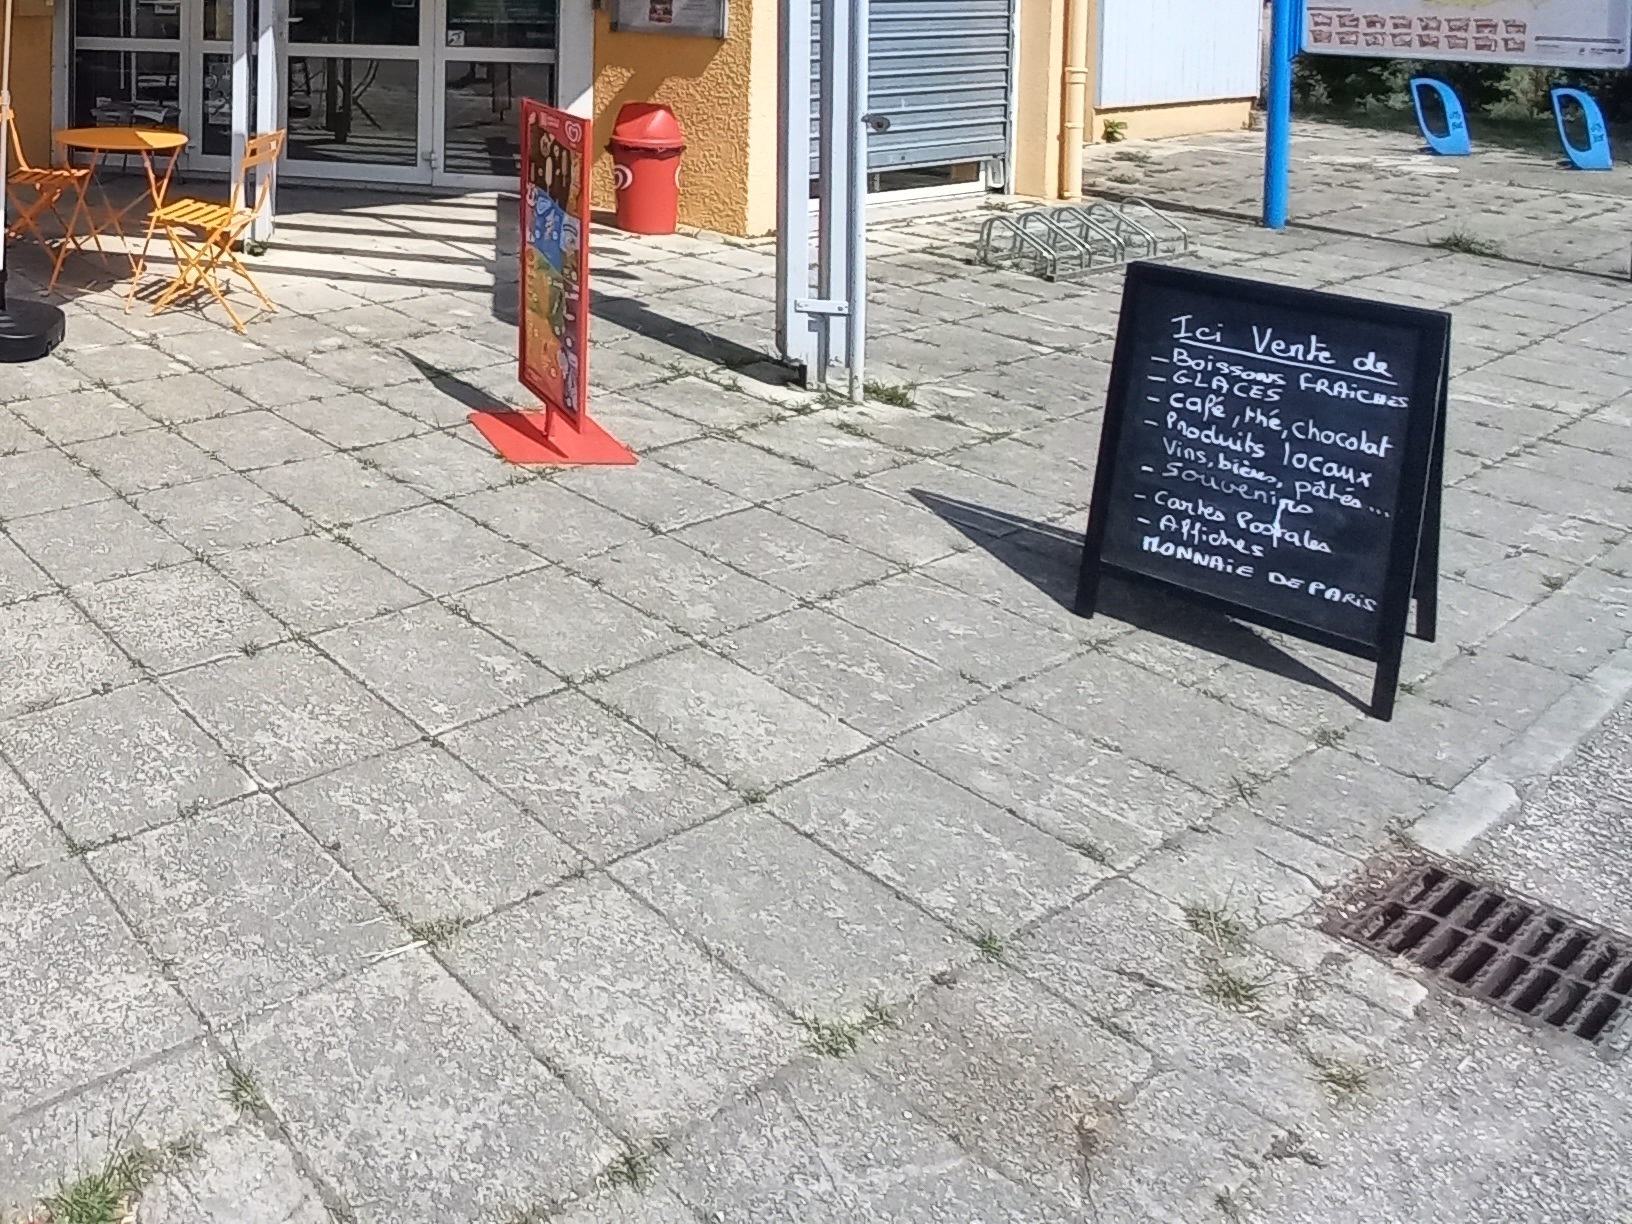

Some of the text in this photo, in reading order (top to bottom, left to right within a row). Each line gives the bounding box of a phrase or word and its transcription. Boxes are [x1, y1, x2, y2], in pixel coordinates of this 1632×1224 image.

[1171, 315, 1393, 378] Ici Vente de
[1173, 347, 1287, 385] Boissons
[1172, 370, 1283, 402] GLACES
[1167, 411, 1372, 487] Produits locaux
[1154, 491, 1225, 521] Cartes
[1160, 514, 1264, 557] Affiches
[1268, 572, 1305, 589] DE
